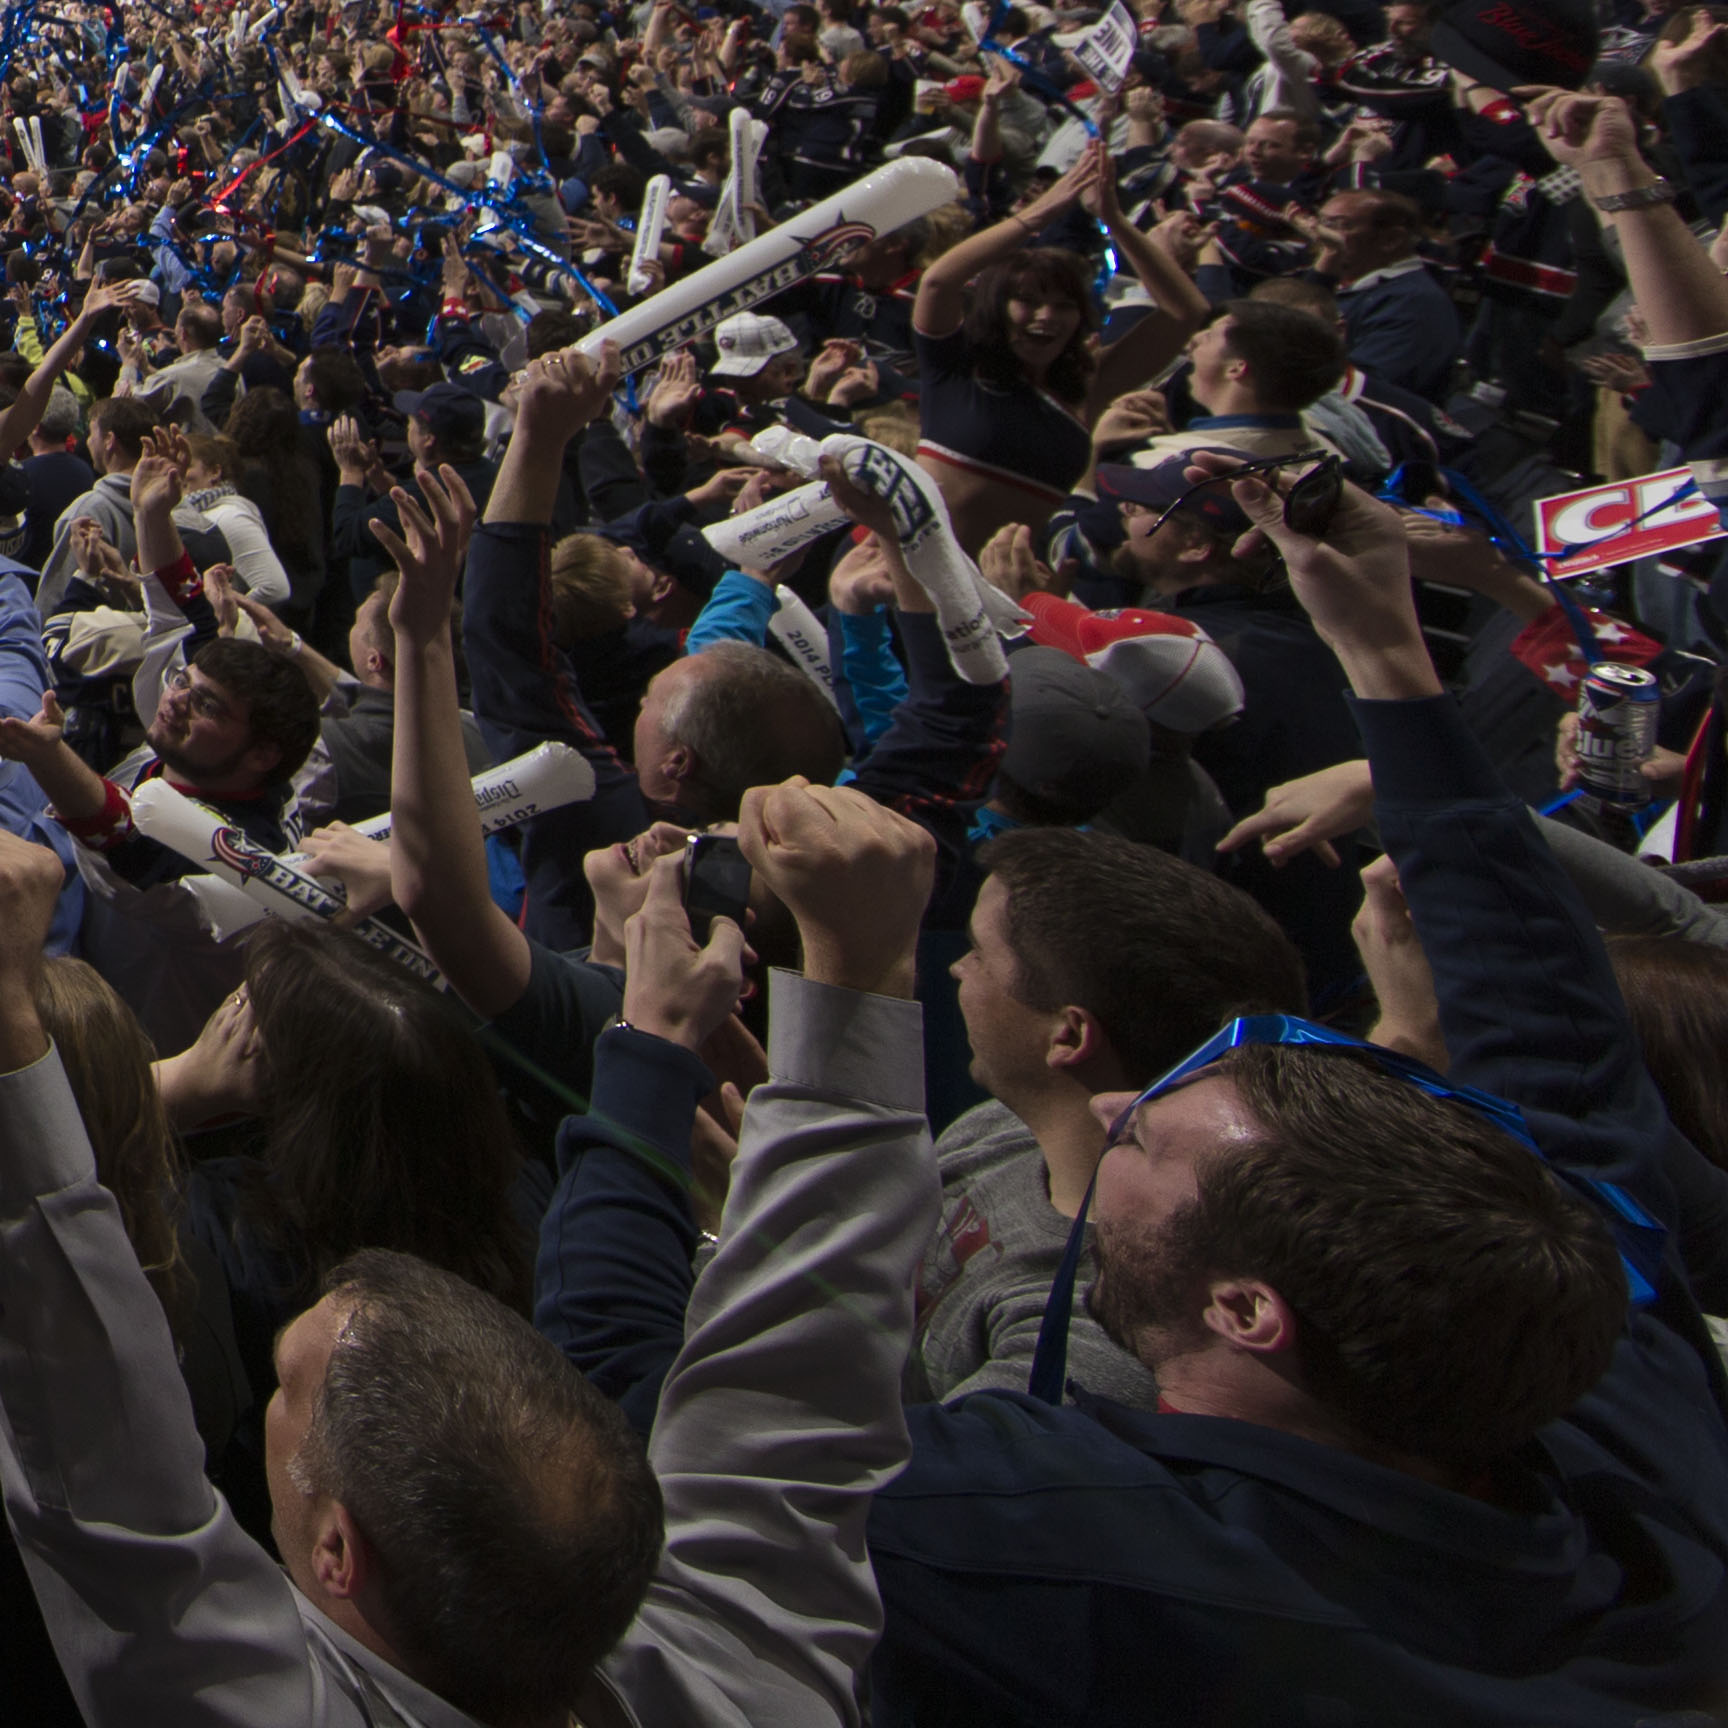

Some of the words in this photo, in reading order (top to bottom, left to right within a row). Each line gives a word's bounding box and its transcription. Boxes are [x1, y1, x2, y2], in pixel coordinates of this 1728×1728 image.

[658, 258, 803, 349] BATTLE
[786, 629, 815, 662] 2014
[474, 779, 524, 808] Dispa
[493, 803, 542, 829] 2014
[268, 866, 386, 951] BATE
